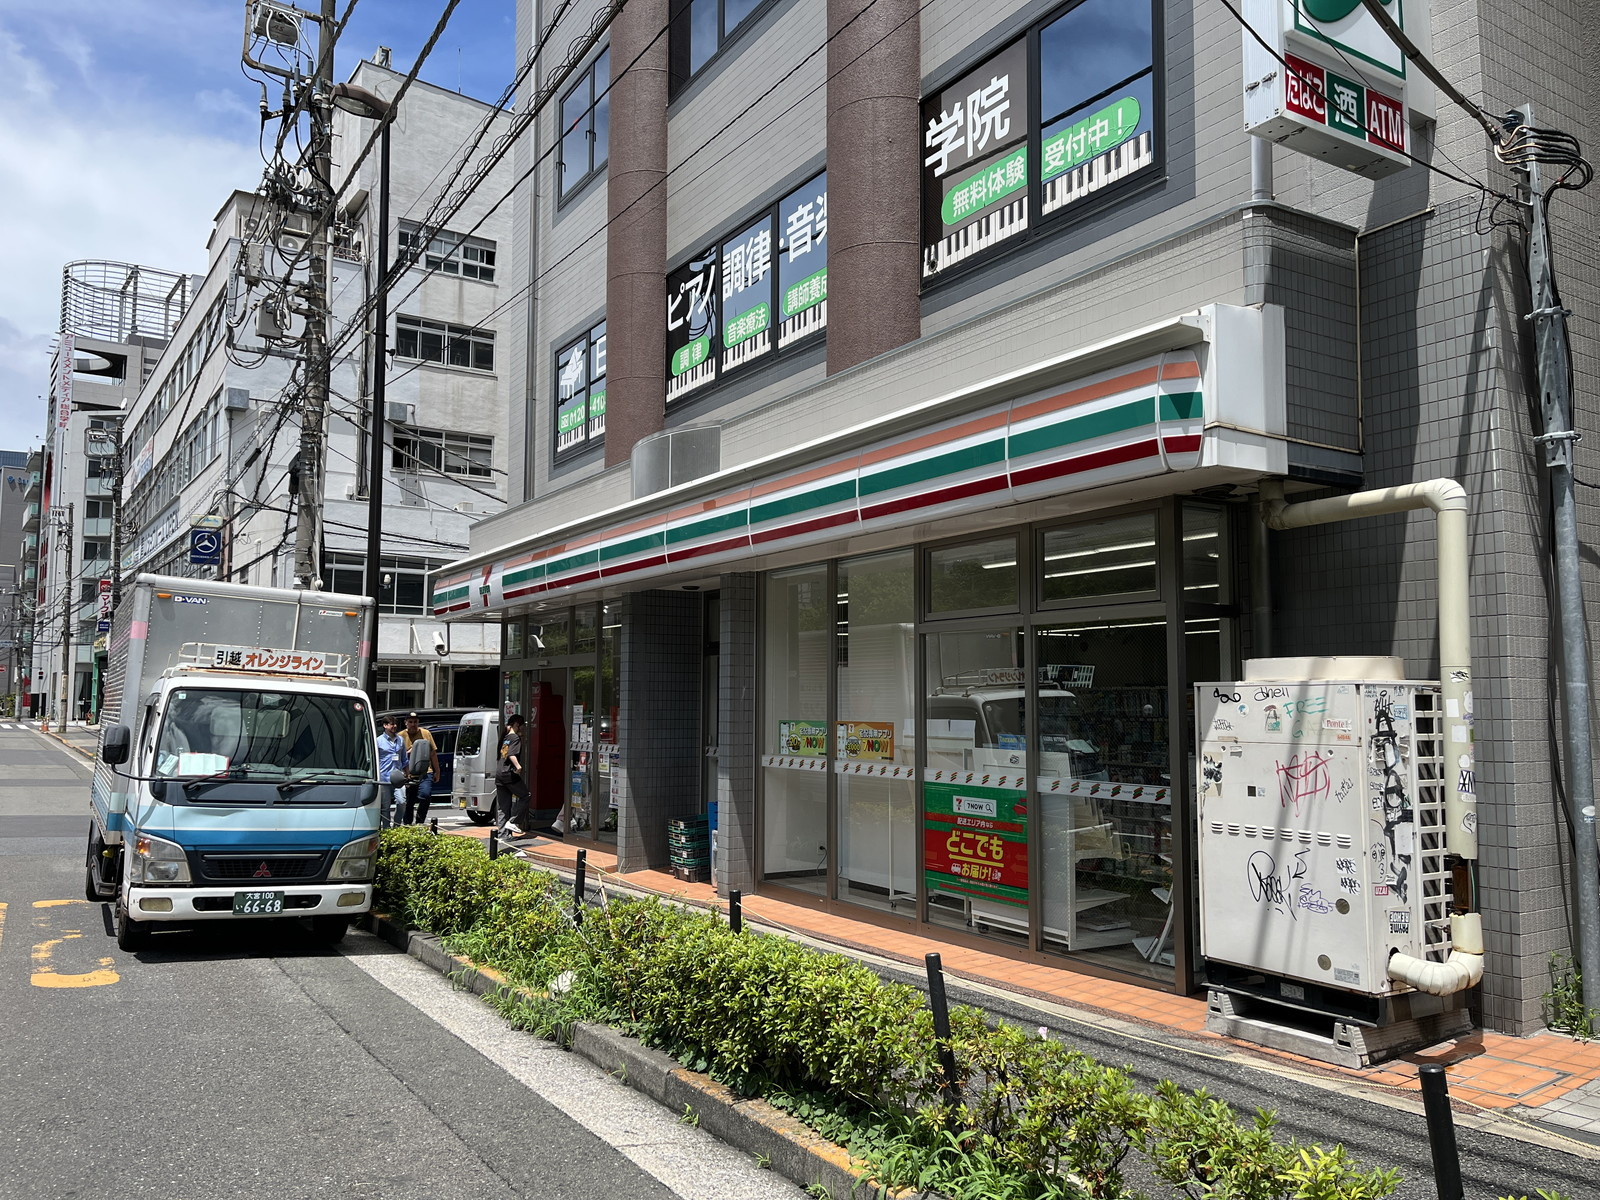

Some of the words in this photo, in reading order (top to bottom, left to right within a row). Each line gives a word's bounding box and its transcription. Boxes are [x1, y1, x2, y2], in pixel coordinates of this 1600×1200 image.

[1286, 65, 1325, 115] たばこ
[1333, 82, 1359, 129] 酒
[924, 73, 1011, 178] 学院
[1369, 100, 1403, 146] ATM
[952, 154, 1025, 218] 無料体験
[667, 264, 716, 332] ピアノ
[727, 306, 767, 344] 音楽療法
[216, 649, 242, 667] 引越
[245, 652, 325, 671] オレンジライン
[802, 736, 825, 749] 7NOW
[862, 739, 889, 753] 7NOW
[967, 802, 984, 811] 7NOW
[946, 829, 1004, 860] どこでも
[243, 899, 282, 913] 66-68
[262, 892, 275, 900] 100
